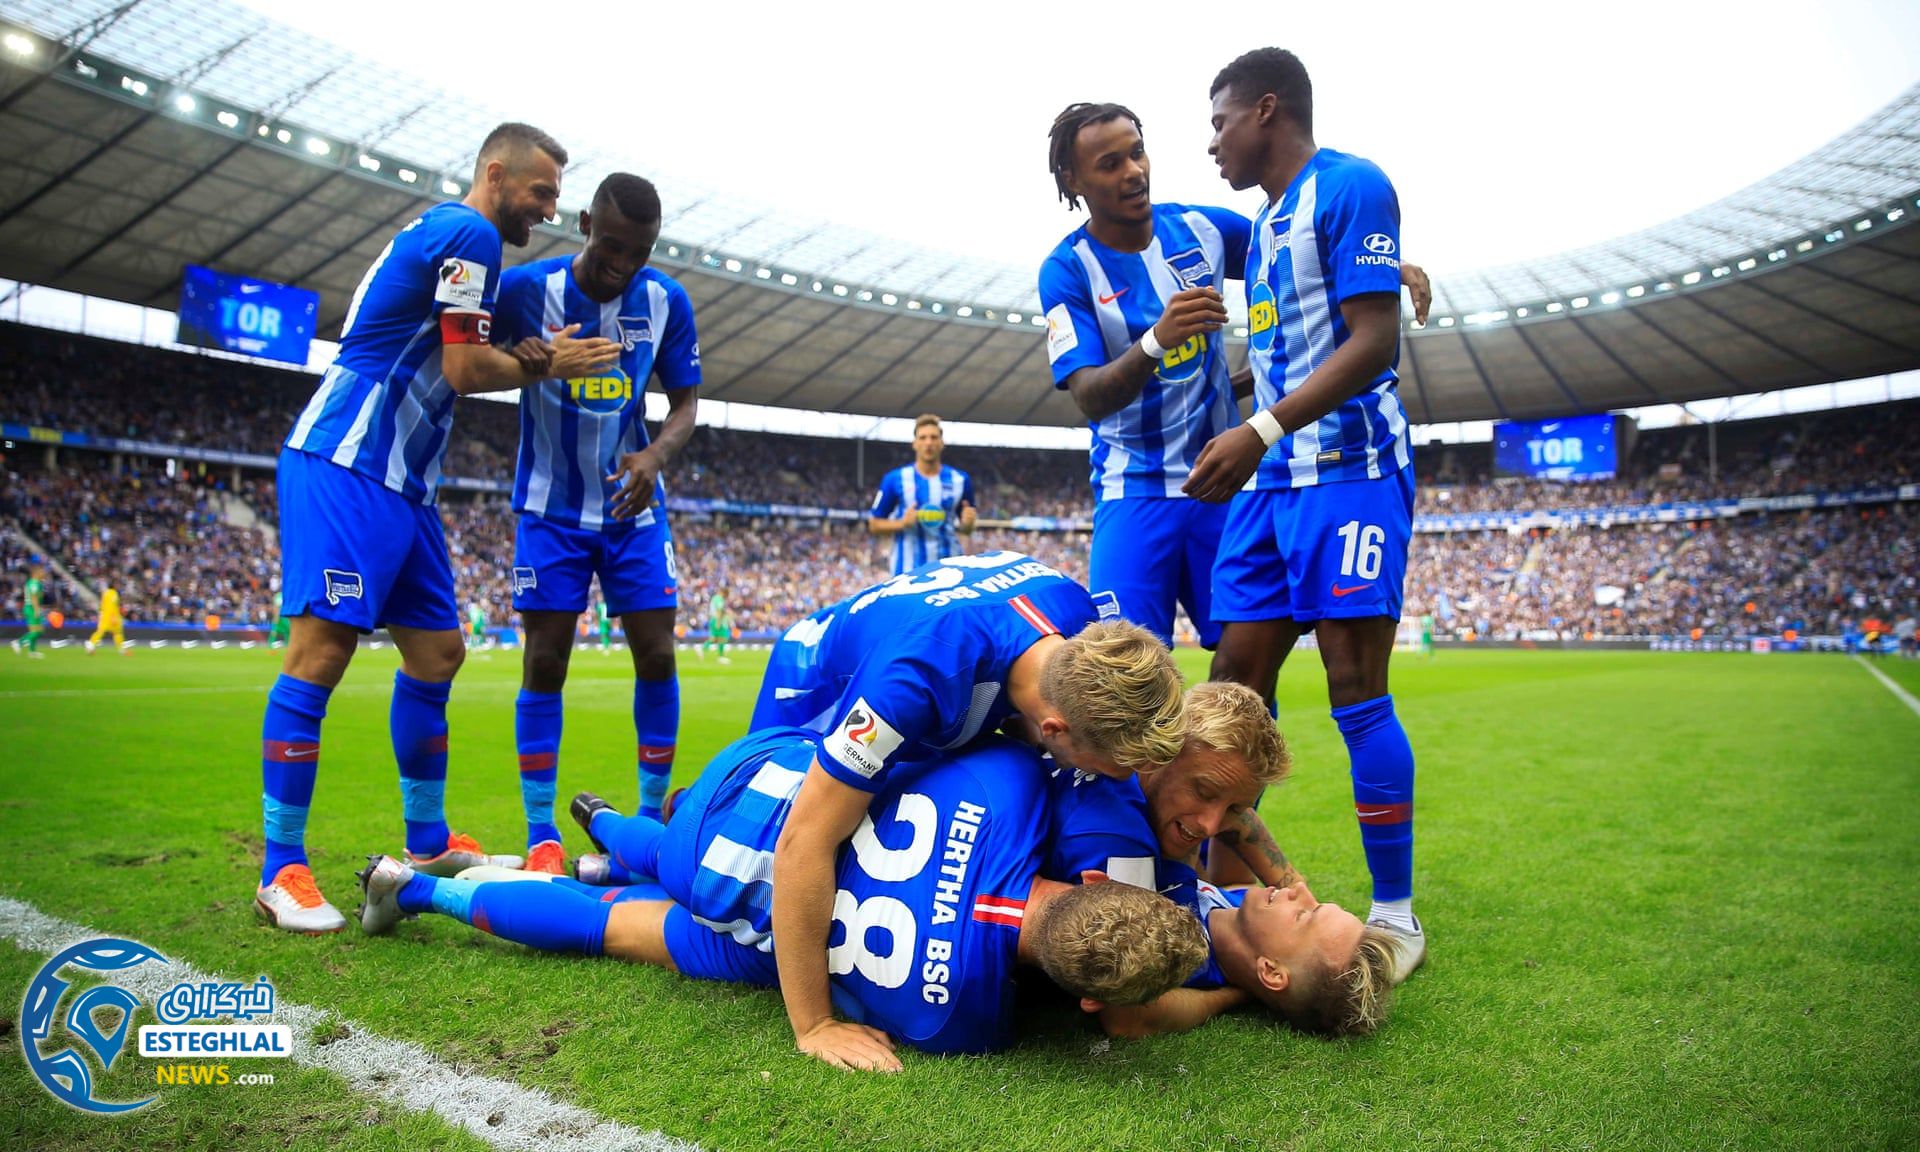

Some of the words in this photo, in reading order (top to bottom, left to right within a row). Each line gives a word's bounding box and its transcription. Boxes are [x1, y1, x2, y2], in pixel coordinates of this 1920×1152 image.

[1355, 255, 1400, 270] HYUNDA
[219, 297, 282, 338] TOR
[1249, 297, 1278, 337] EDi
[1153, 332, 1208, 374] EDi
[1526, 437, 1583, 466] TOR
[664, 541, 677, 579] 8
[1337, 520, 1386, 580] 16
[931, 800, 987, 925] HERTHA
[828, 792, 939, 990] 28
[922, 940, 953, 1005] BSC
